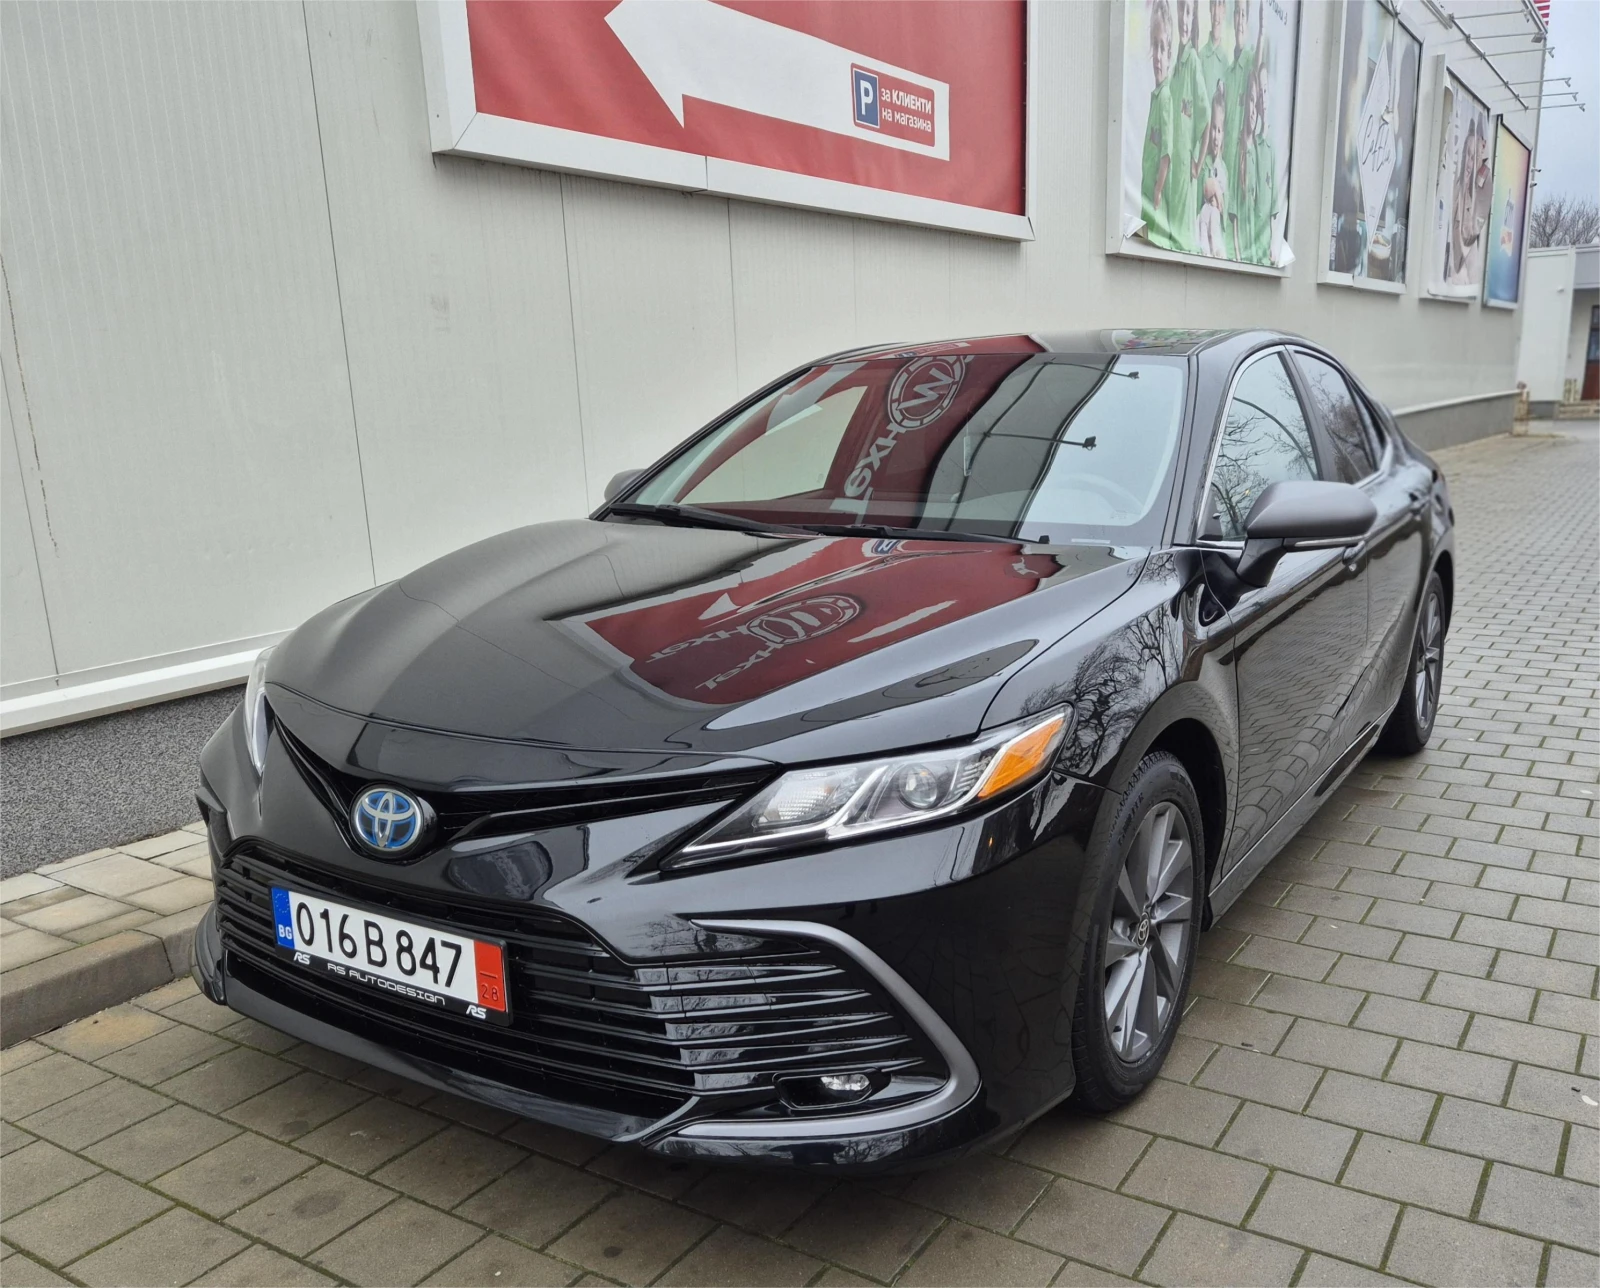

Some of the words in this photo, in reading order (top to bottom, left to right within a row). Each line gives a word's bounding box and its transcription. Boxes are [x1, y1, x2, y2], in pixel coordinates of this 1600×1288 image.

[860, 80, 874, 116] P
[881, 88, 890, 102] за
[892, 89, 932, 115] КЛИЕНТИ
[882, 107, 892, 121] на
[894, 110, 932, 132] магазина
[278, 923, 293, 940] BG
[293, 952, 312, 965] RS
[327, 963, 346, 975] RS
[349, 969, 446, 1006] AUTODESIGN
[480, 983, 499, 1002] 28
[465, 1004, 487, 1020] RS
